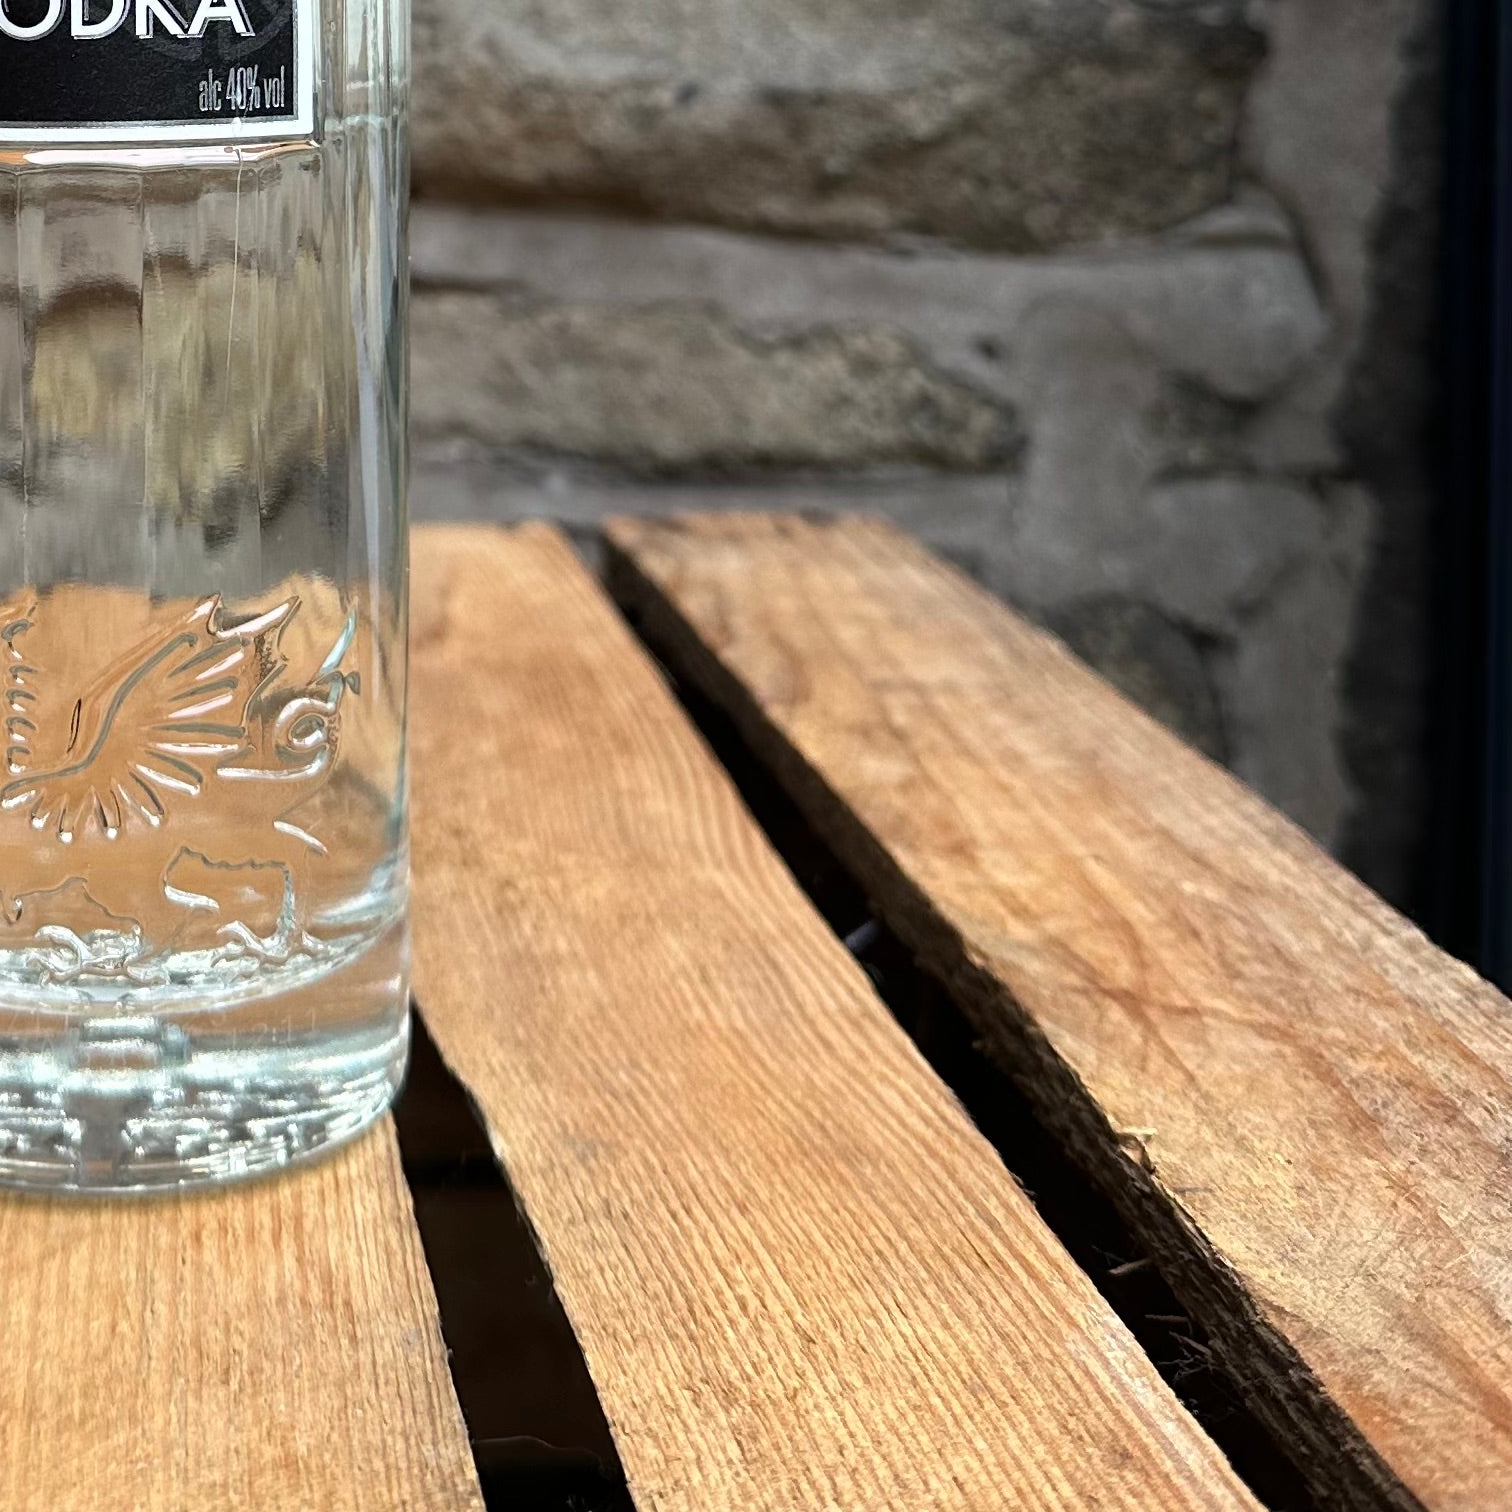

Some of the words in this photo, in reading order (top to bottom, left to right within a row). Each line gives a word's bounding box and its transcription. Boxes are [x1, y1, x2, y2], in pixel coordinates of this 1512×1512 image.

[198, 68, 222, 112] alc
[225, 64, 261, 111] 40%
[263, 64, 285, 109] vol
